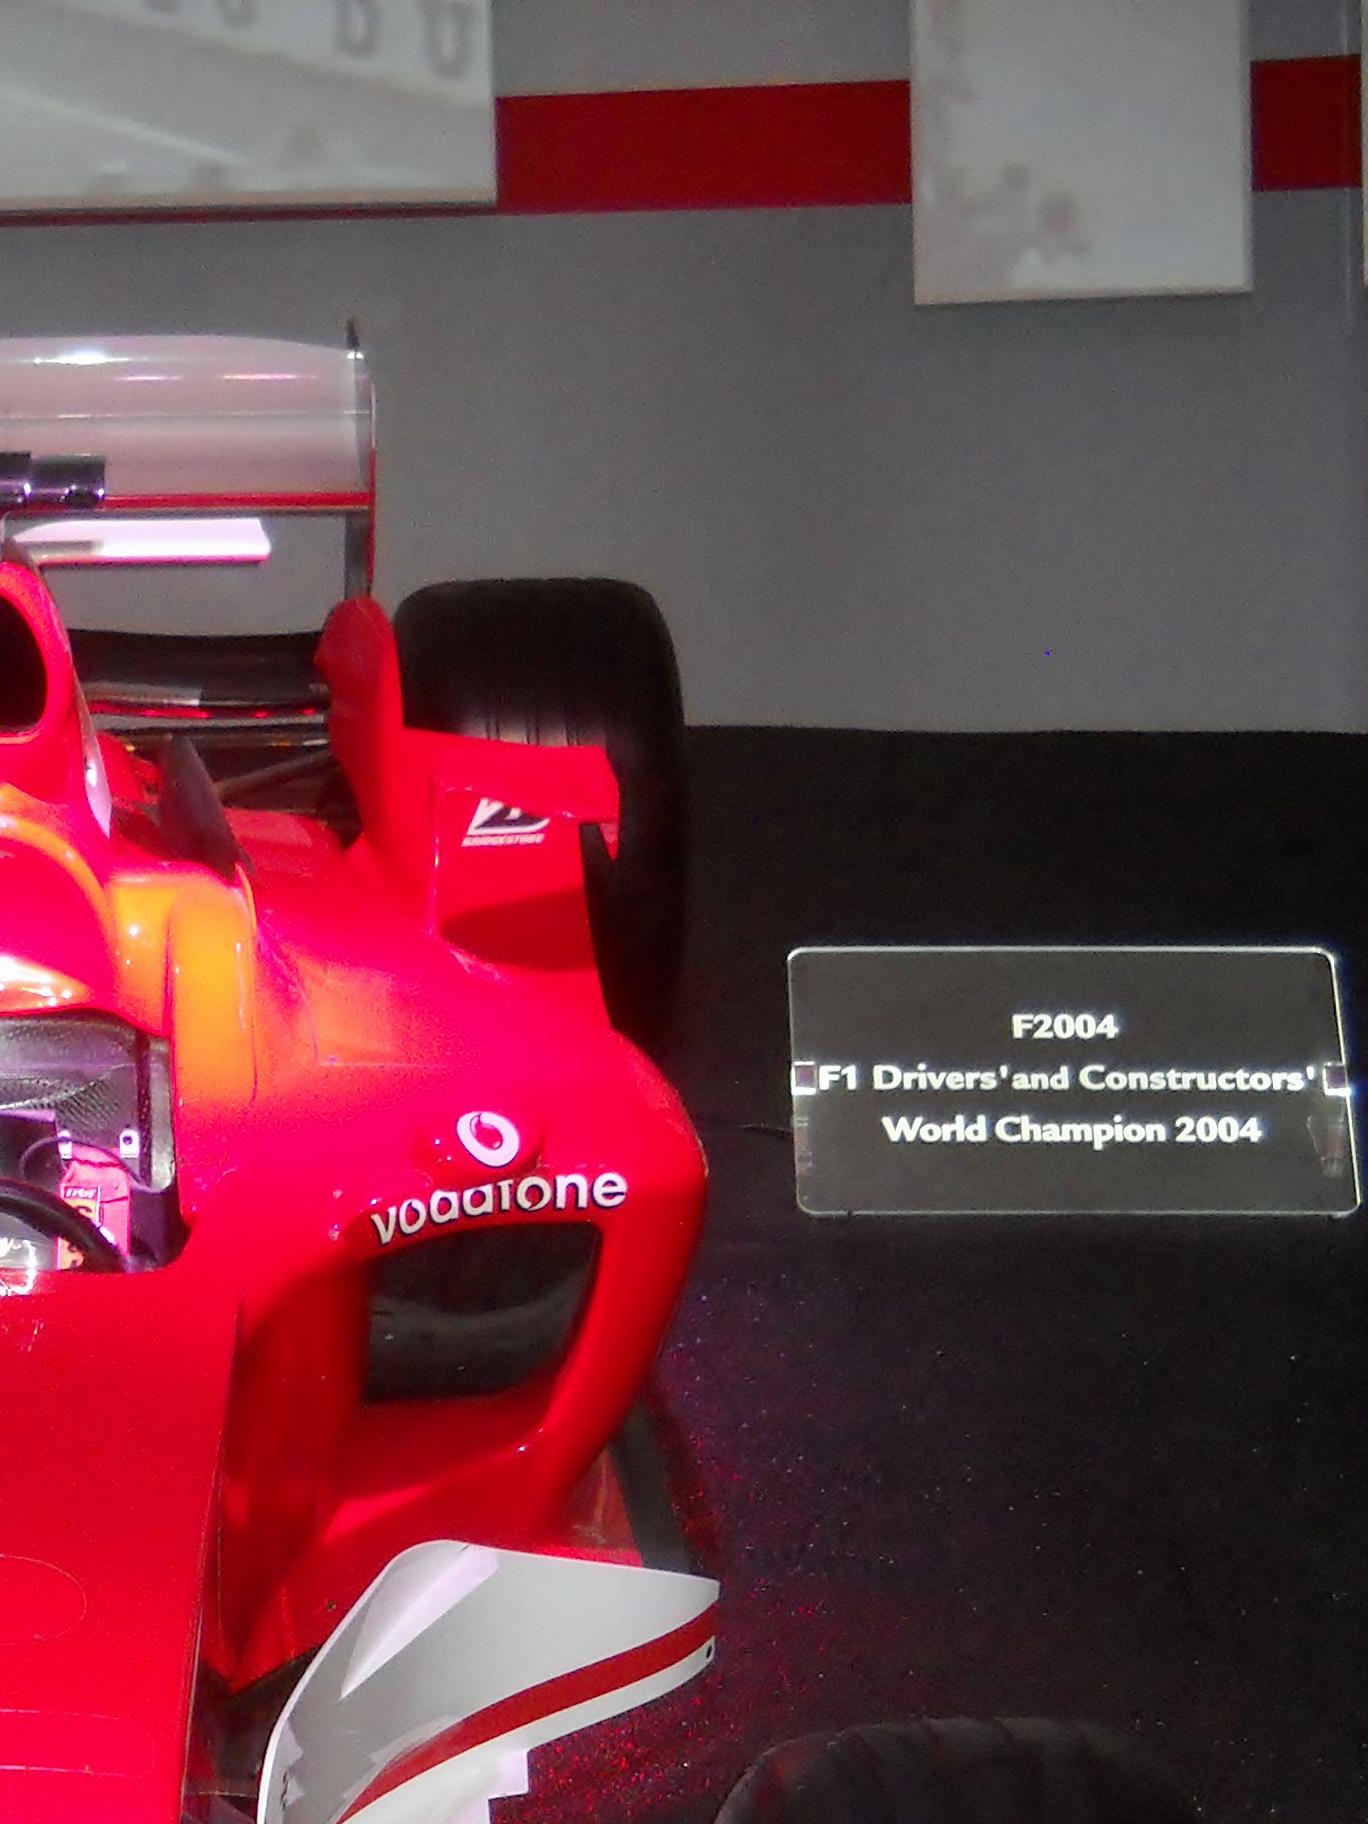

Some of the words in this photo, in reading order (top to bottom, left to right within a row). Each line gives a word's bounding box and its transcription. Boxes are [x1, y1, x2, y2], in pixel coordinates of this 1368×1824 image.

[1011, 1012, 1120, 1040] F2004
[818, 1064, 858, 1090] F1
[873, 1062, 1009, 1091] Drivers'
[1011, 1064, 1071, 1091] and
[1078, 1063, 1317, 1092] Constructors'
[882, 1113, 988, 1143] World
[994, 1113, 1168, 1151] Champion
[1174, 1114, 1263, 1144] 2004
